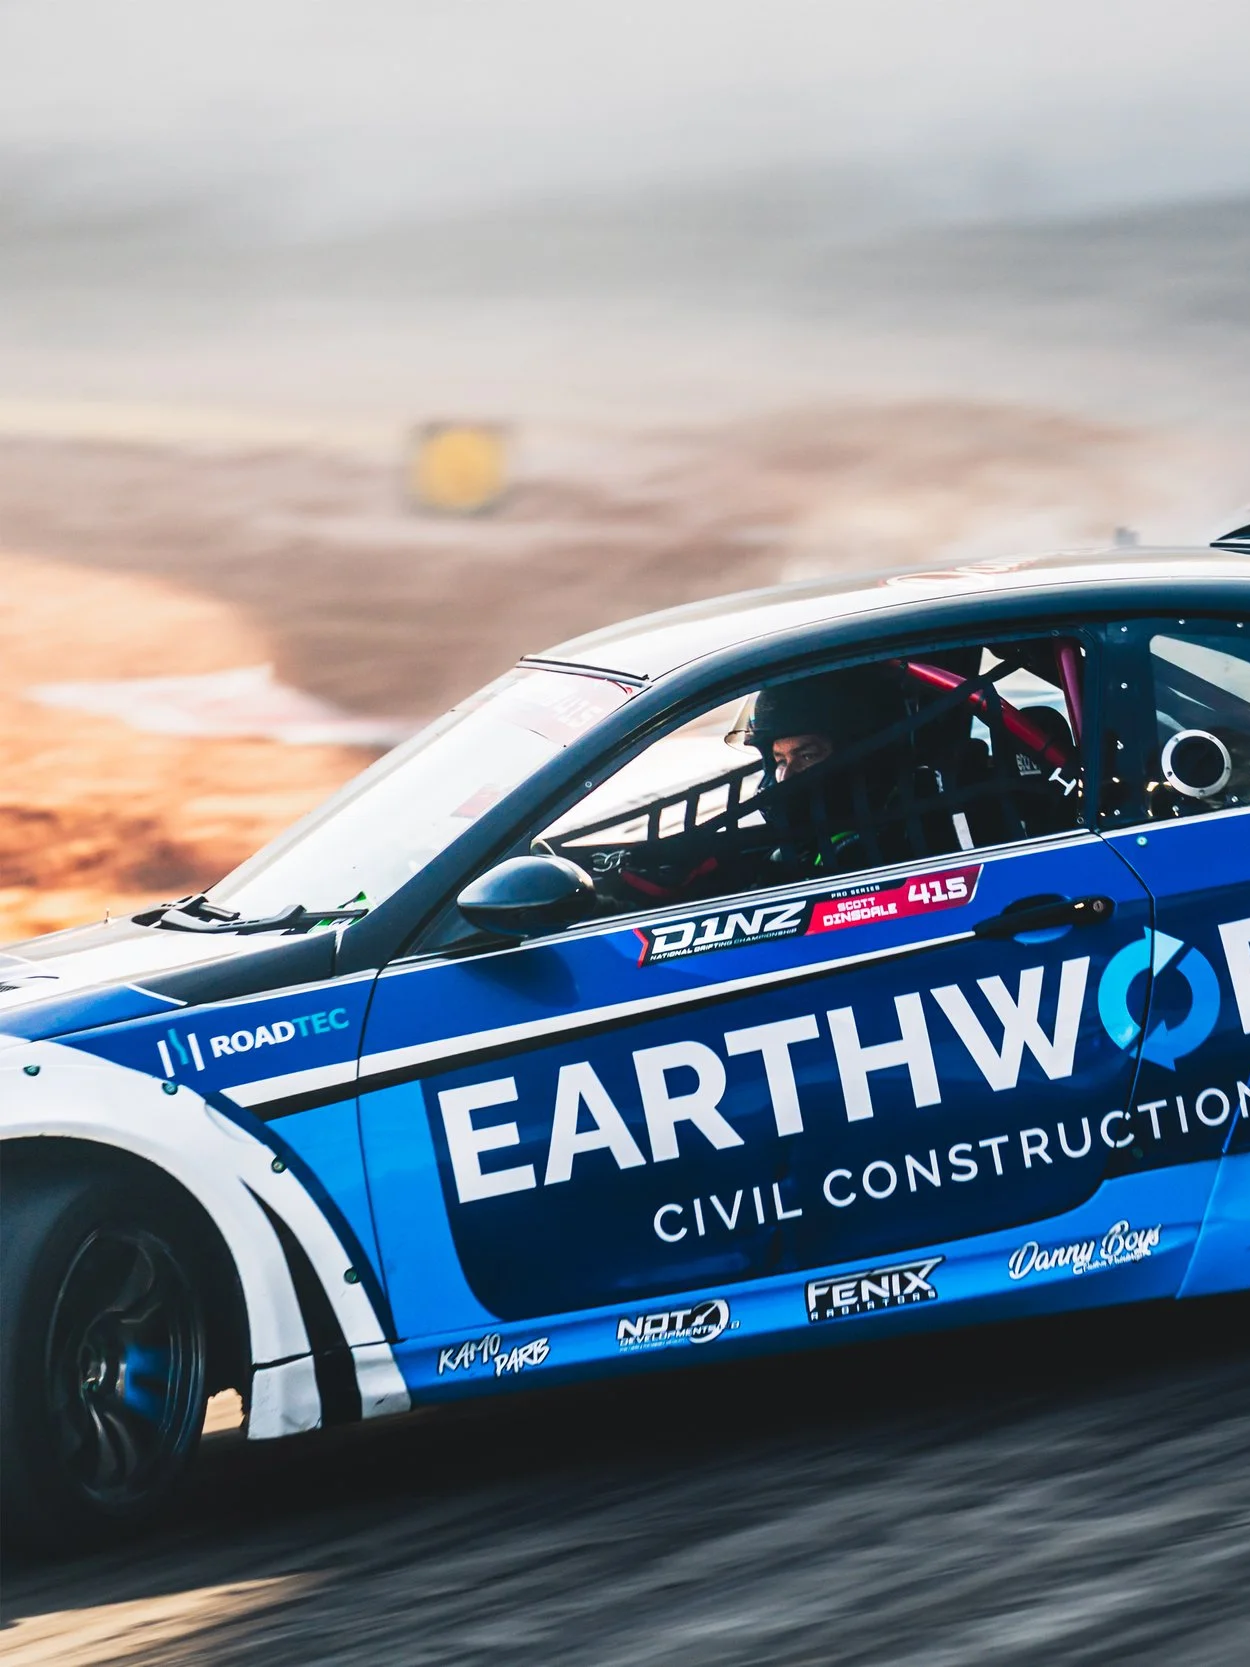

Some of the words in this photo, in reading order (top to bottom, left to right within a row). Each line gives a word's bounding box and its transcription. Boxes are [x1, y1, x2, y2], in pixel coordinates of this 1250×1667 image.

[837, 896, 876, 912] SCOTT
[851, 884, 881, 896] SERIES
[907, 876, 969, 905] 415
[650, 899, 807, 955] D1NZ
[822, 902, 898, 927] DINSDALE
[650, 948, 693, 962] NATIONAL
[693, 939, 734, 954] DRIFTING
[733, 927, 798, 946] CHAMPIONSHIP
[209, 1007, 350, 1059] ROADTEC
[653, 1181, 803, 1244] CIVIL
[1008, 1240, 1096, 1281] Danny
[1100, 1219, 1162, 1261] Boys
[807, 1256, 943, 1313] FENIX
[810, 1288, 937, 1321] RADIATORS
[438, 1332, 501, 1375] KAMO
[495, 1337, 550, 1377] PARTS
